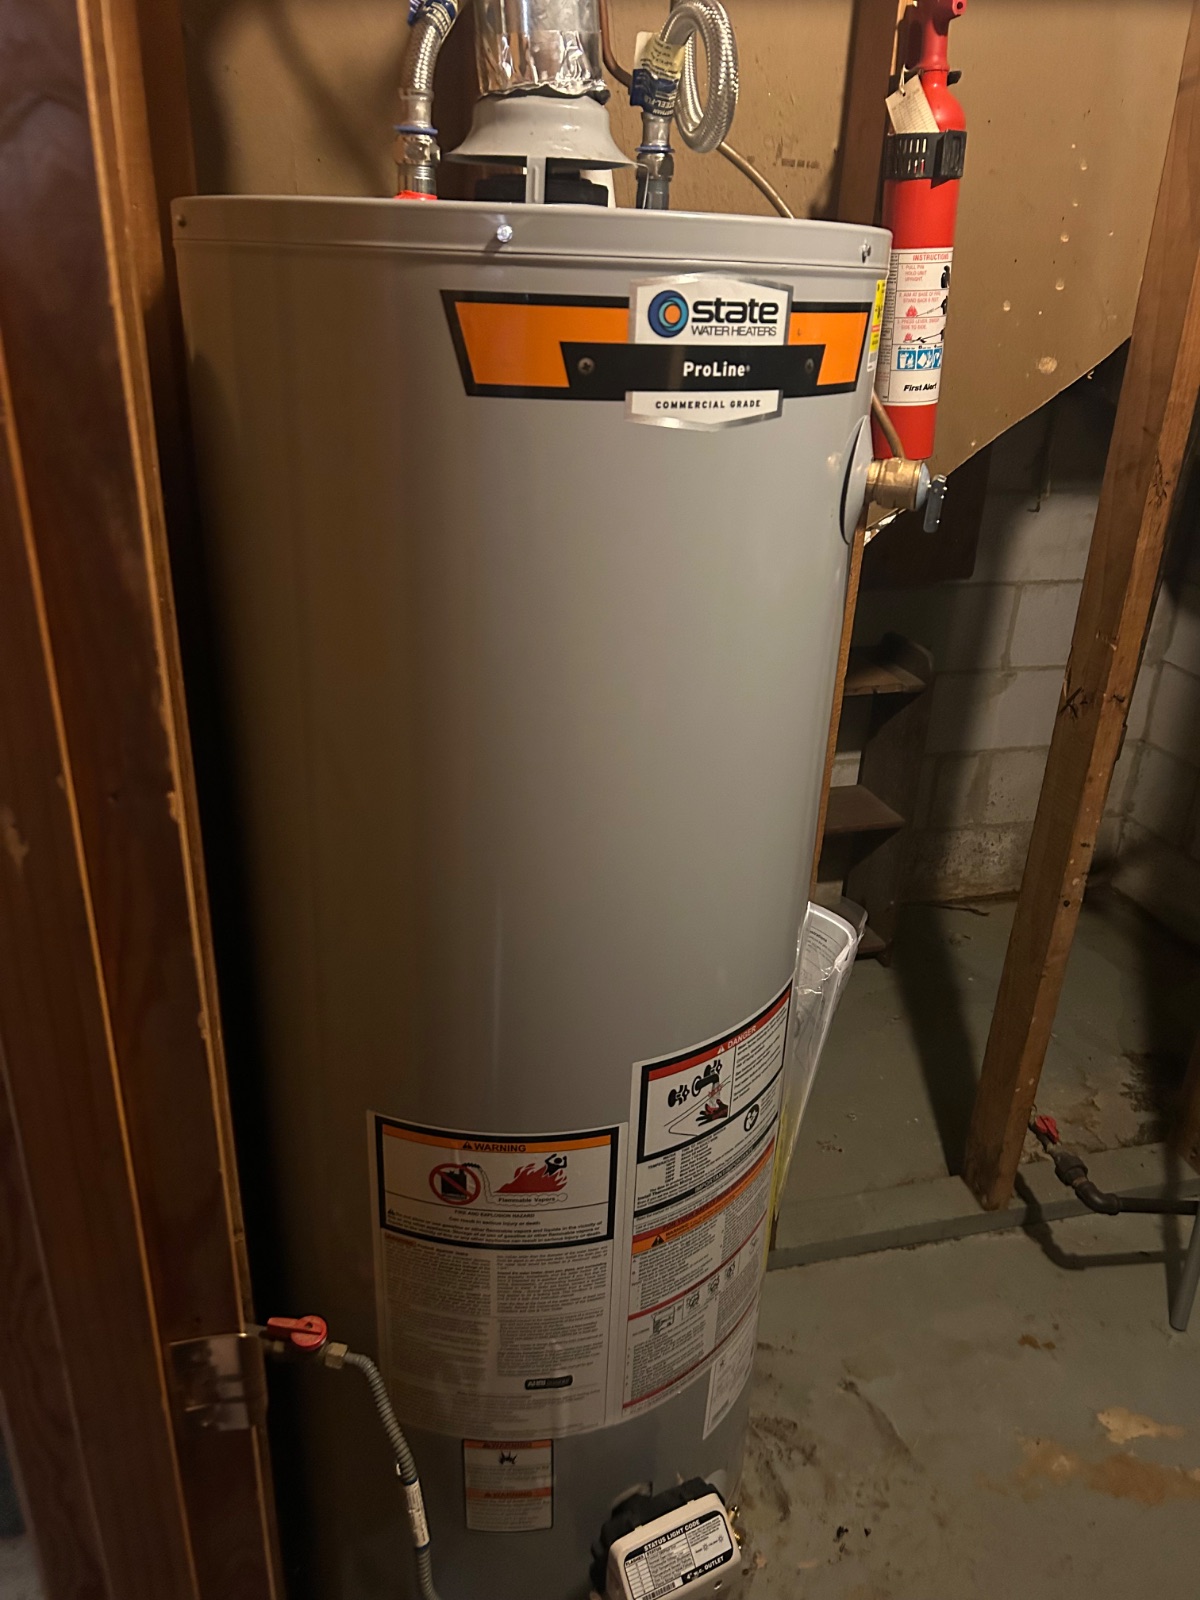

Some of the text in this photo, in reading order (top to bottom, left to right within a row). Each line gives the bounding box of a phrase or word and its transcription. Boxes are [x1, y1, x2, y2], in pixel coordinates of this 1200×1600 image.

[692, 297, 779, 324] state
[692, 325, 777, 337] WATER HEATERS
[655, 400, 761, 409] COMMERCIAL GRADE
[727, 1025, 757, 1049] DANGER
[474, 1142, 526, 1152] WARNING
[644, 1536, 667, 1552] STATUS
[666, 1526, 684, 1541] LIGHT
[684, 1519, 700, 1531] CODE
[704, 1555, 724, 1570] OUTLET
